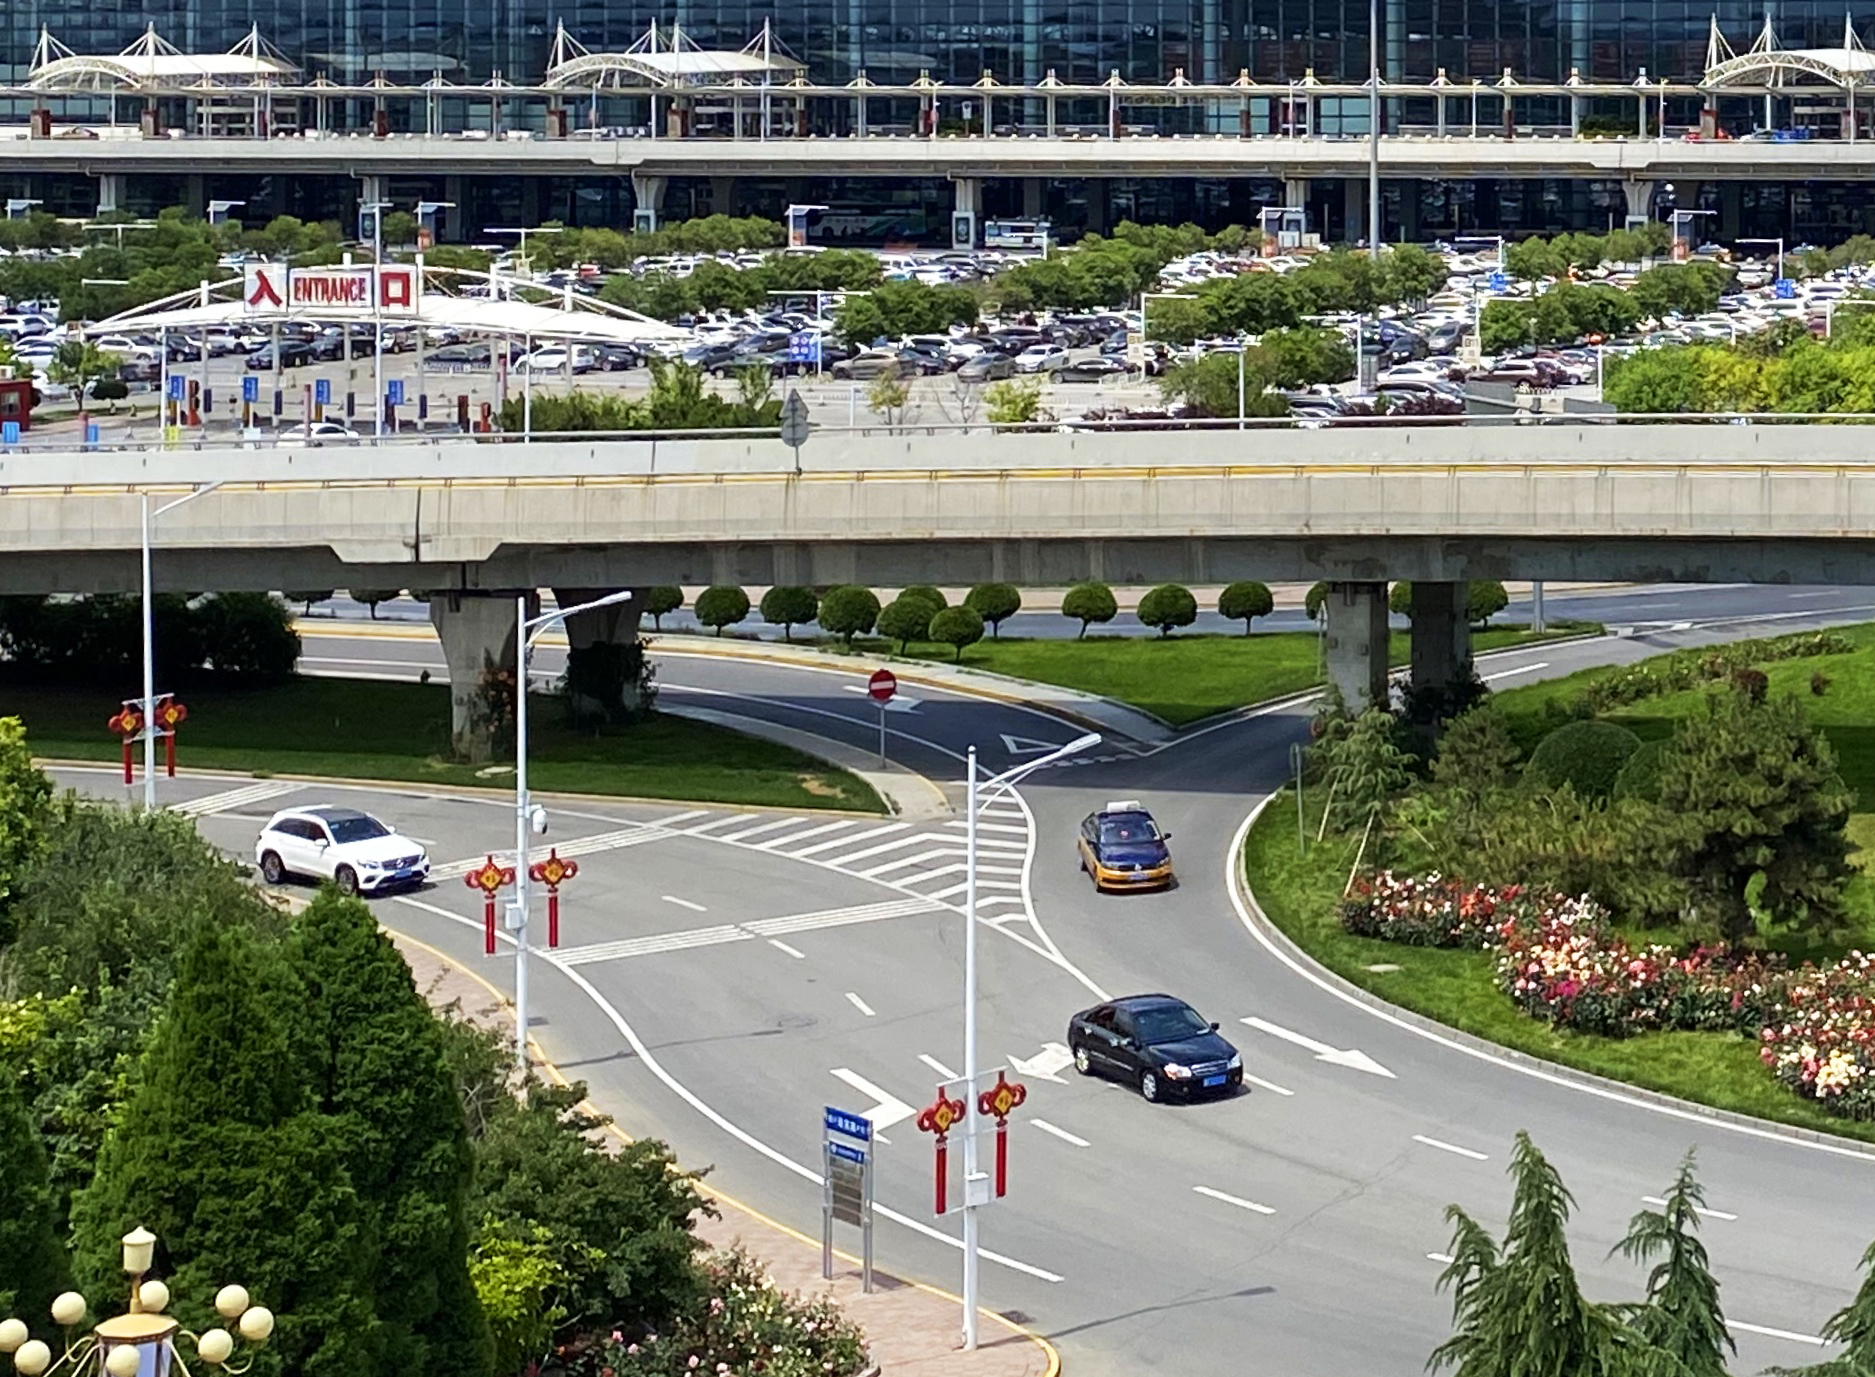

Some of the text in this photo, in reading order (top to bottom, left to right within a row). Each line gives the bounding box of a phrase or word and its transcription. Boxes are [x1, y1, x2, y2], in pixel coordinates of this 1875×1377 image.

[249, 269, 411, 307] 入 ENTRANCE 口
